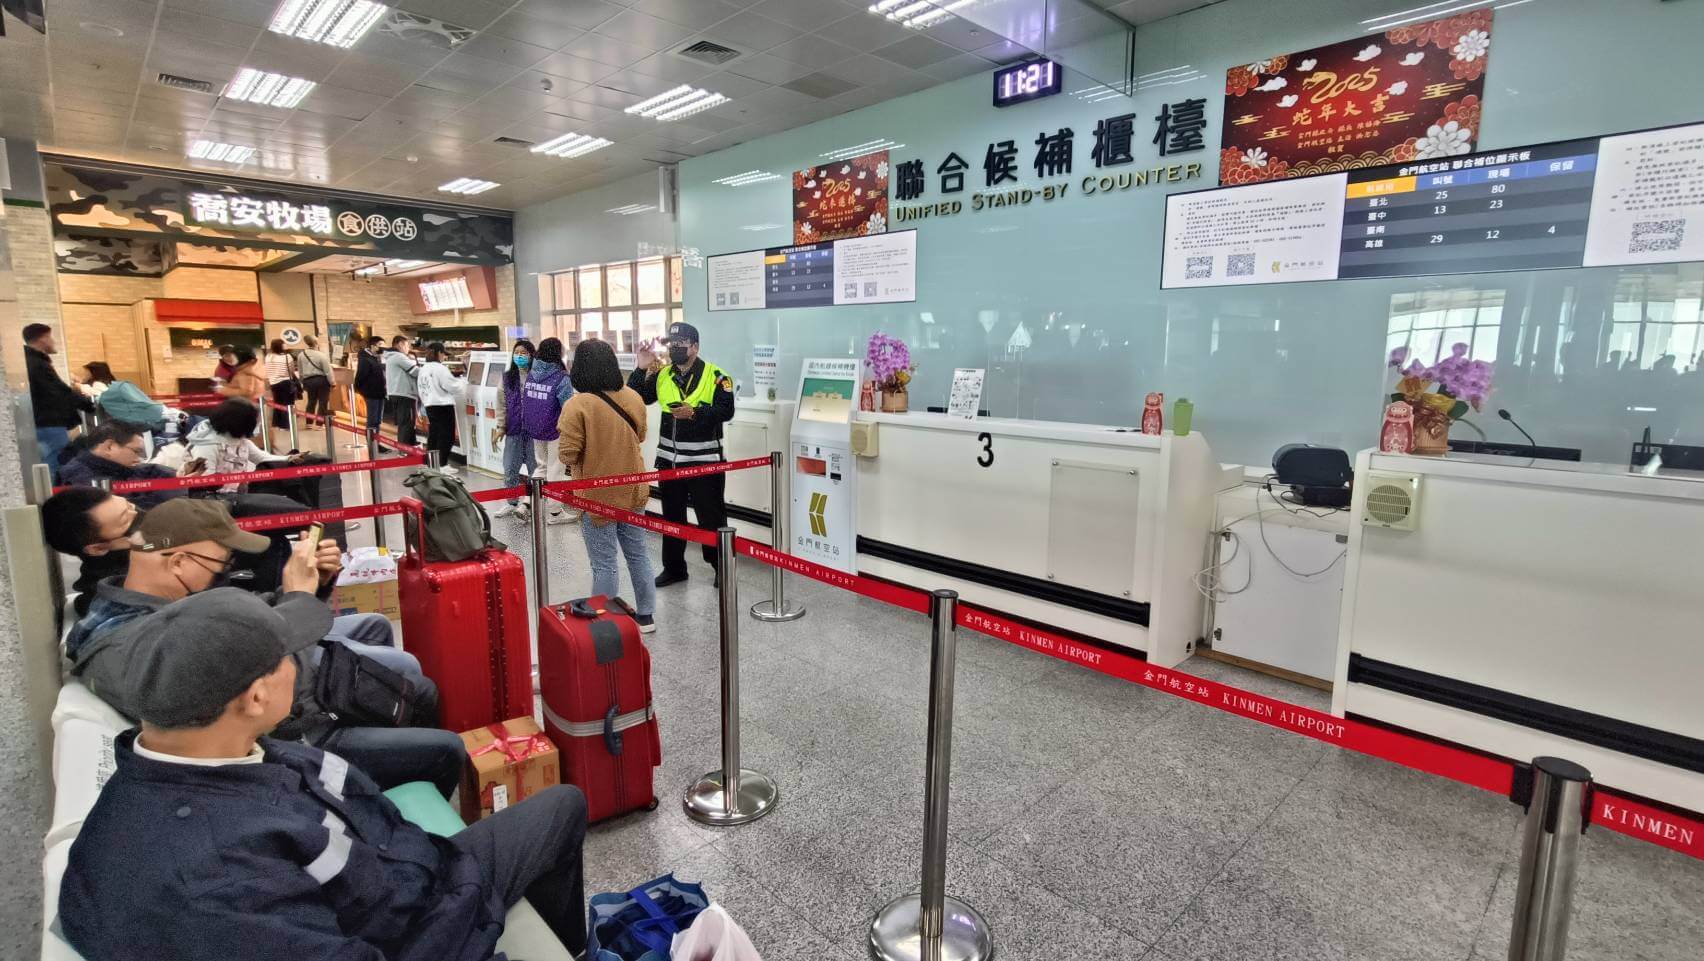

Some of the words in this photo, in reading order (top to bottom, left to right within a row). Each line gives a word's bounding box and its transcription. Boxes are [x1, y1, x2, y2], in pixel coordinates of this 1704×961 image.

[1003, 61, 1053, 97] 11:21
[1292, 93, 1390, 126] 蛇年大吉
[895, 98, 1208, 202] 聯合候補櫃檯
[1399, 161, 1450, 177] 金門航空站
[1451, 150, 1531, 171] 聯合補位顯示板
[1432, 175, 1454, 186] 叫號
[1487, 167, 1511, 179] 現場
[1550, 160, 1575, 173] 保留
[896, 201, 962, 222] UNIFIED
[972, 183, 1070, 212] STAND-BY
[1081, 161, 1203, 196] COUNTER
[1434, 205, 1447, 215] 13
[1489, 199, 1504, 209] 23
[1435, 190, 1449, 200] 25
[1491, 184, 1506, 194] 80
[190, 192, 333, 235] 喬安牧場
[338, 211, 418, 241] 食供站
[1364, 239, 1384, 249] 高雄
[1430, 234, 1444, 244] 29
[1486, 229, 1500, 240] 12
[1547, 225, 1556, 235] 4
[977, 431, 995, 468] 3
[120, 481, 152, 490] AIRPORT
[279, 514, 310, 525] KINMEN
[312, 510, 345, 521] AIRPORT
[797, 536, 840, 556] 金門航空站
[779, 556, 811, 573] KINMEN
[815, 568, 856, 587] AIRPORT
[965, 612, 1011, 636] 金門航空站
[1019, 630, 1054, 649] KINMEN
[1058, 643, 1102, 665] AIRPORT
[1143, 669, 1209, 698] 金門航空站
[1223, 692, 1274, 718] KINMEN
[1279, 710, 1346, 739] AIRPORT
[1603, 804, 1695, 846] KINMEN
